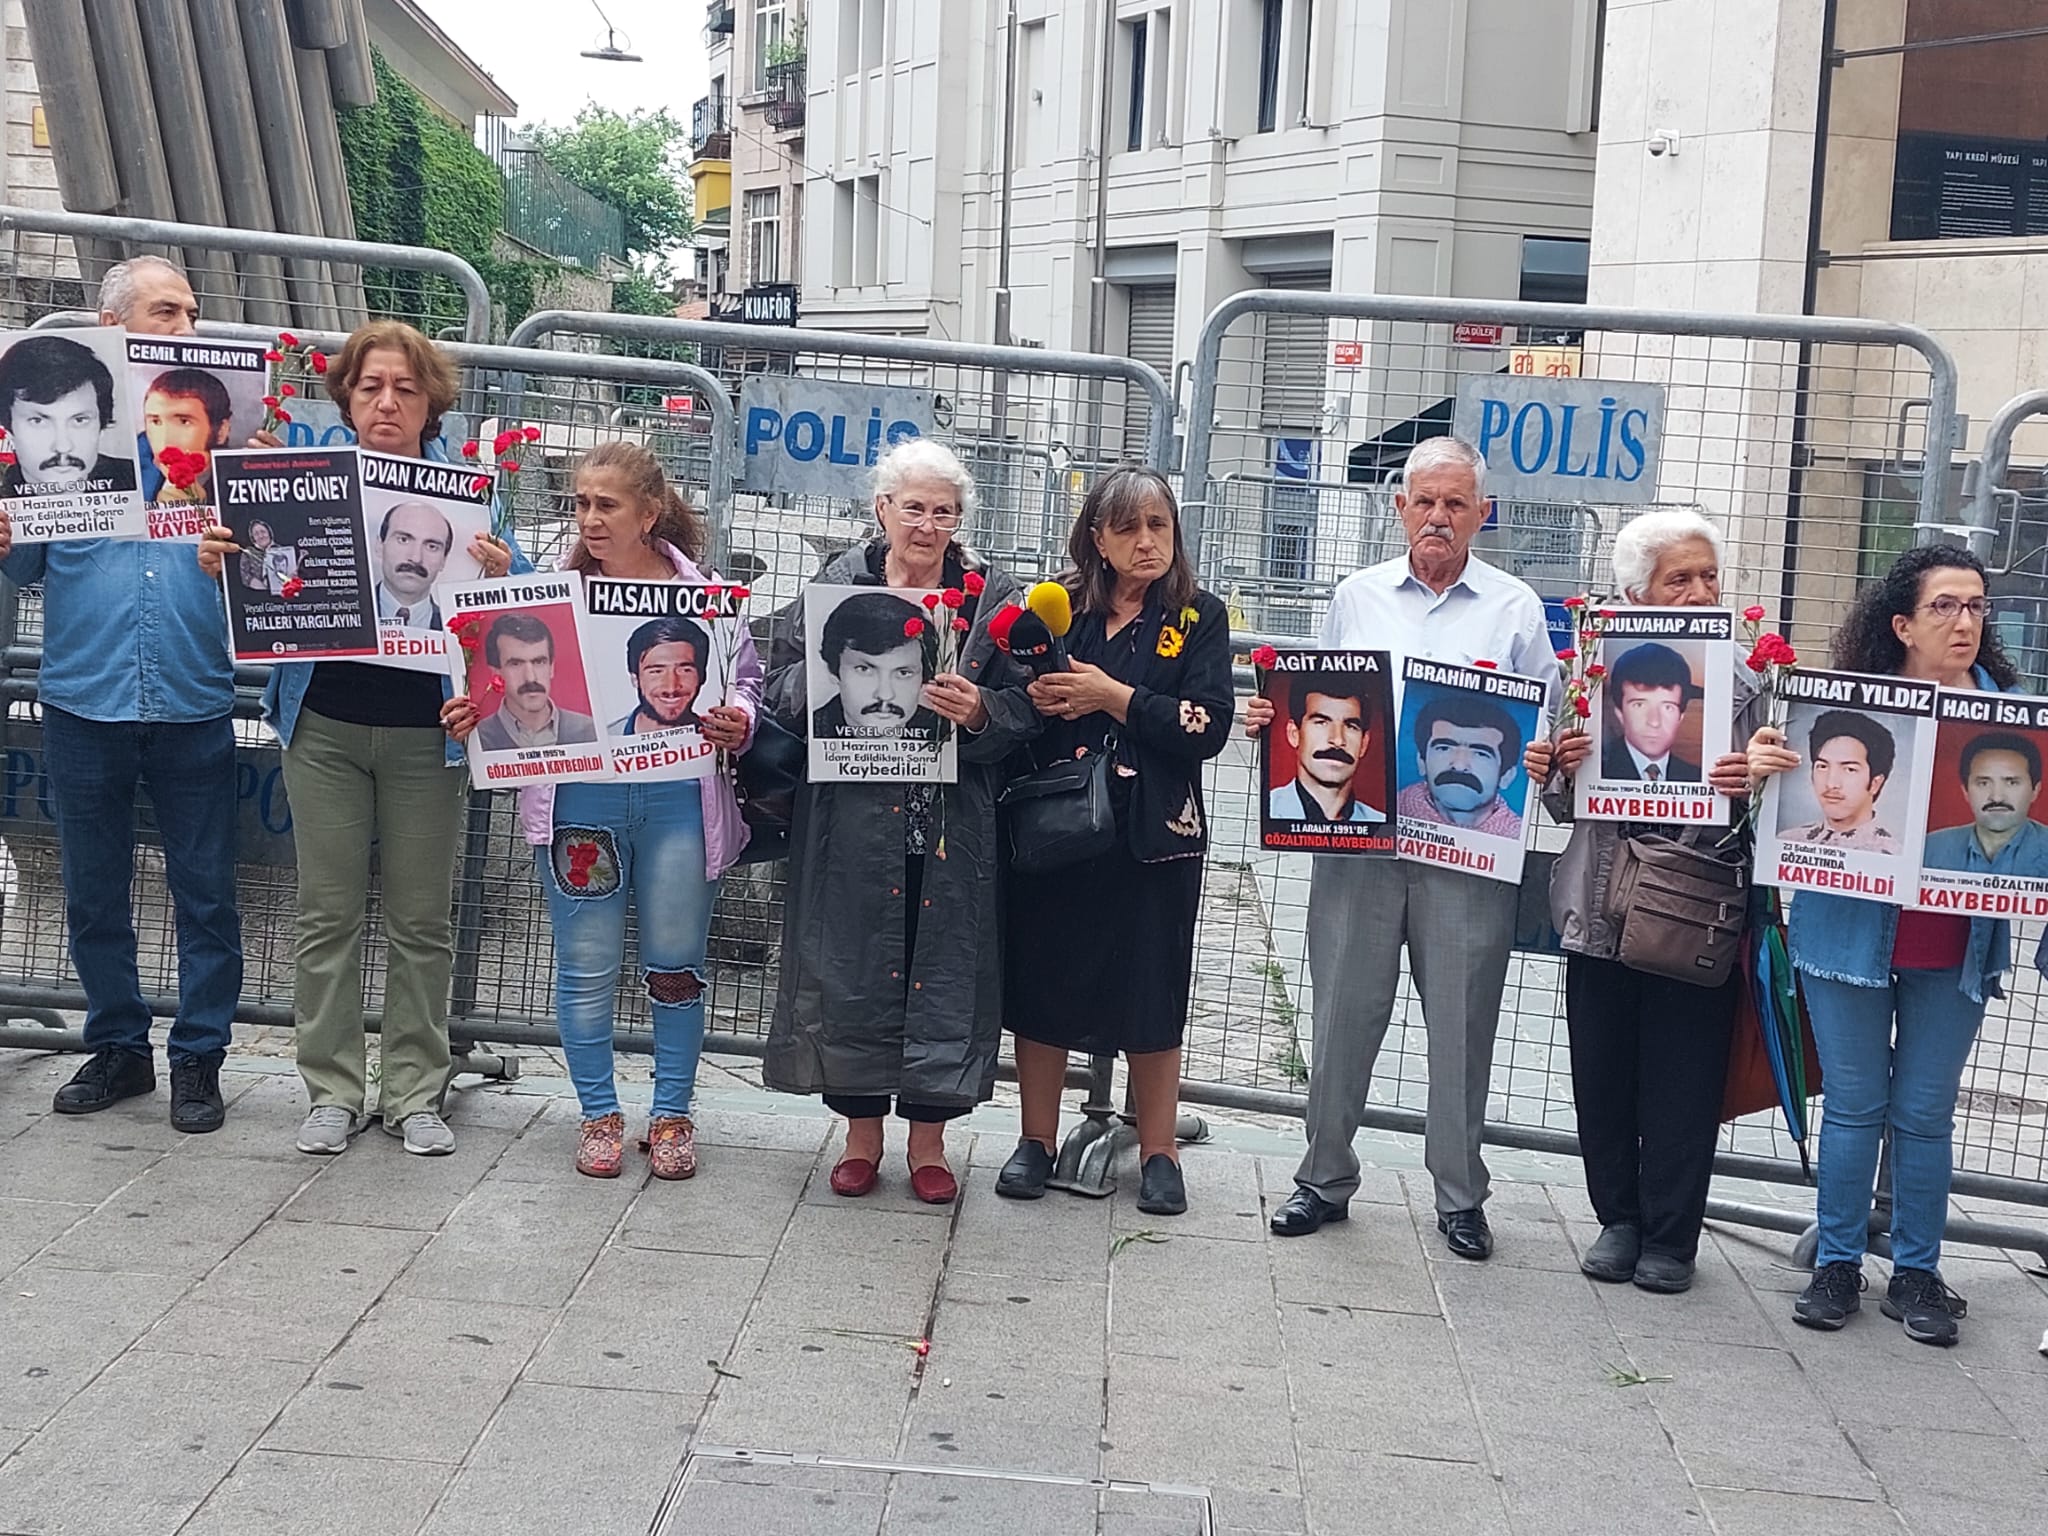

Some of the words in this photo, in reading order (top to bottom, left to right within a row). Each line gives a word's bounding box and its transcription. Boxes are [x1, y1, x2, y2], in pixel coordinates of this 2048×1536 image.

[1945, 151, 1963, 161] YAPI
[745, 292, 791, 320] KUAFÖR
[129, 343, 178, 363] CEMİL
[182, 347, 258, 368] KIRBAYIR
[1479, 397, 1649, 482] POLİS
[14, 481, 63, 495] VEYSEL
[65, 476, 114, 492] GÜNEY
[227, 478, 290, 504] ZEYNEP
[293, 472, 349, 501] GÜNEY
[414, 466, 481, 498] KARAKO
[23, 497, 73, 510] Haziran
[79, 494, 129, 507] 1981'de
[9, 511, 34, 522] dam
[38, 507, 89, 521] Edildikten
[93, 503, 124, 517] Sonra
[22, 517, 115, 538] Kaybedildi
[454, 585, 508, 608] FEHMİ
[511, 583, 571, 603] TOSUN
[594, 584, 669, 614] HASAN
[245, 615, 292, 632] FAİLLERİ
[293, 613, 362, 629] YARGILAYIN!
[1688, 618, 1730, 638] ATEŞ
[1274, 652, 1318, 672] AGİT
[1321, 652, 1380, 672] AKİPA
[1406, 658, 1481, 691] İBRAHİM
[1484, 676, 1542, 702] DEMİR
[1778, 674, 1857, 703] MURAT
[1860, 682, 1933, 711] YILDIZ
[1942, 698, 1991, 722] HACI
[1996, 699, 2031, 726] İSA
[835, 725, 881, 738] VEYSEL
[884, 724, 932, 739] GÜNEY
[823, 741, 837, 751] 10
[841, 740, 889, 752] Haziran
[486, 761, 546, 780] GÖZALTINDA
[546, 753, 604, 775] KAYBEDİLDİ
[854, 752, 904, 763] Edildikten
[839, 762, 927, 779] Kaybedildi
[1643, 782, 1716, 796] GÖZALTINDA
[1588, 796, 1713, 820] KAYBEDİLDİ
[1290, 824, 1301, 833] 11
[1302, 824, 1332, 834] ARALIK
[1333, 824, 1369, 835] 1991'DE
[1265, 832, 1330, 848] GÖZALTINDA
[1331, 834, 1395, 850] KAYBEDİLDİ
[1781, 852, 1846, 871] GÖZALTINDA
[1778, 863, 1895, 897] KAYBEDİLDİ
